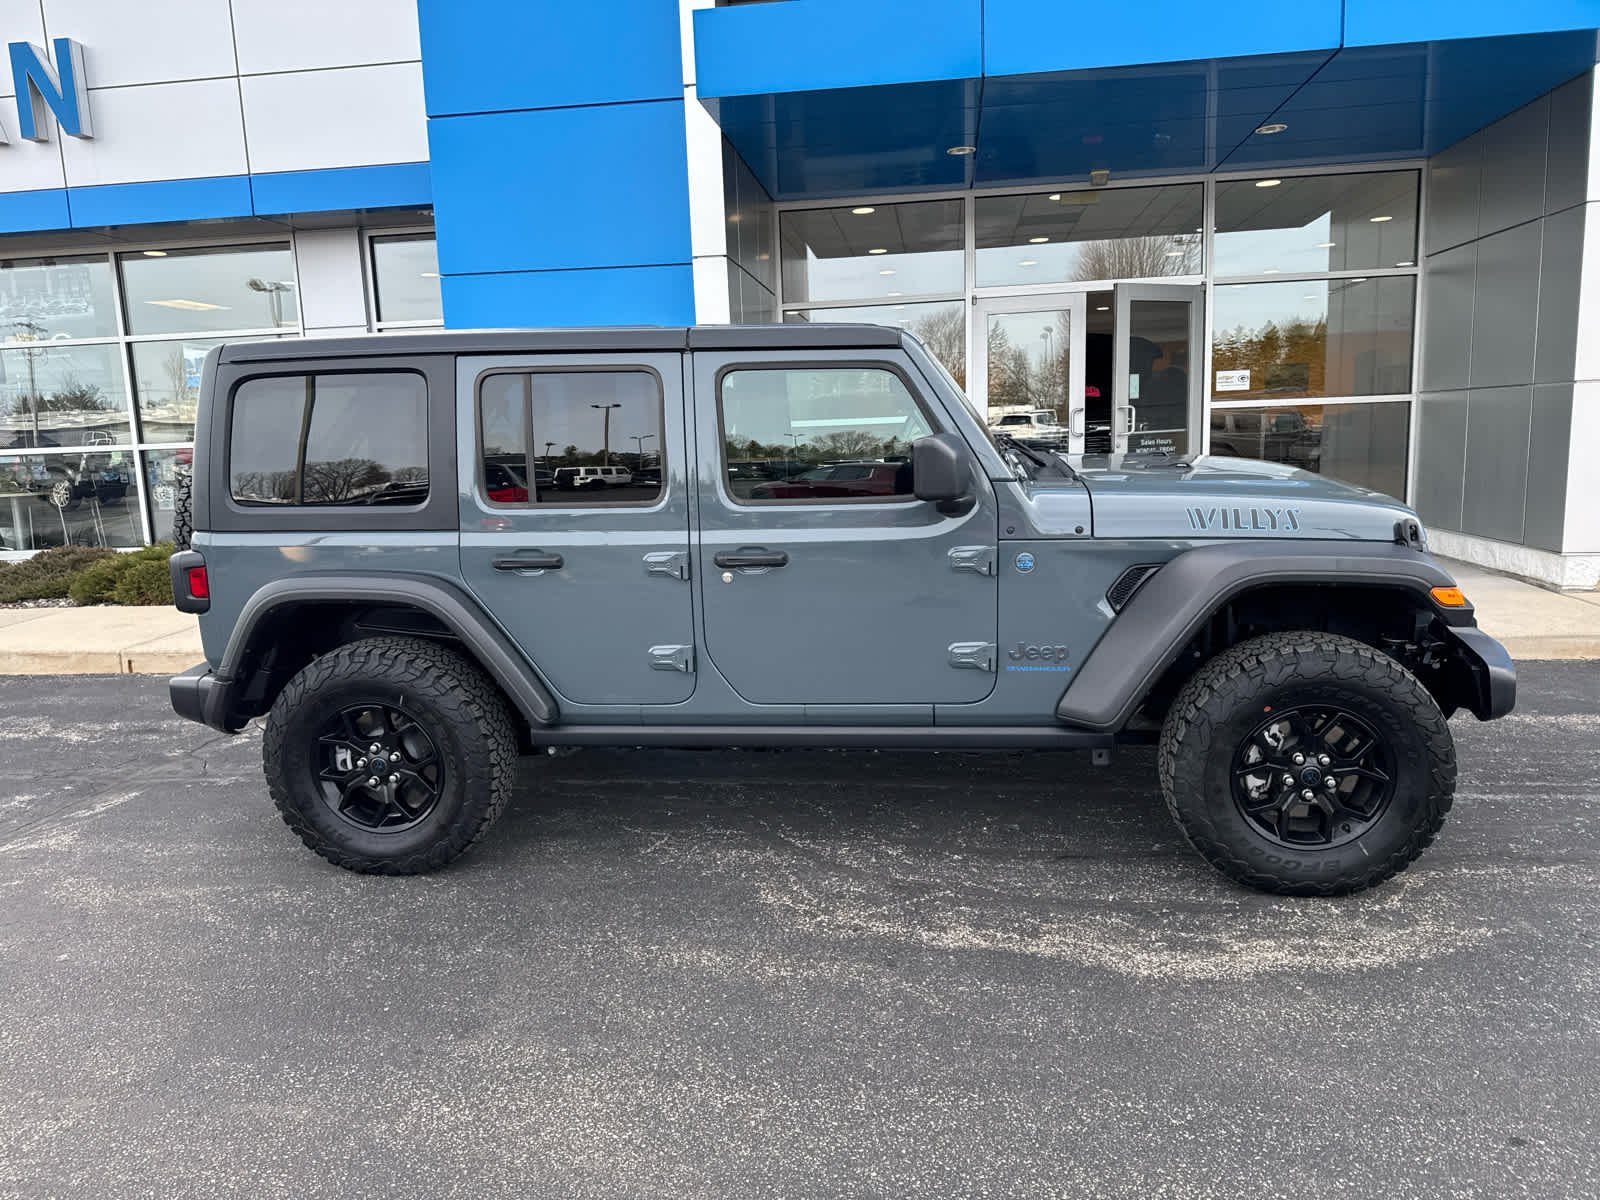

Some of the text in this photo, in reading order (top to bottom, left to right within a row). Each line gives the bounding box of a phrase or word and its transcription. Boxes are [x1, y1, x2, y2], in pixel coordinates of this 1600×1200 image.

[0, 38, 94, 144] N
[1186, 507, 1301, 531] WILLYS
[1008, 641, 1069, 664] Jeep
